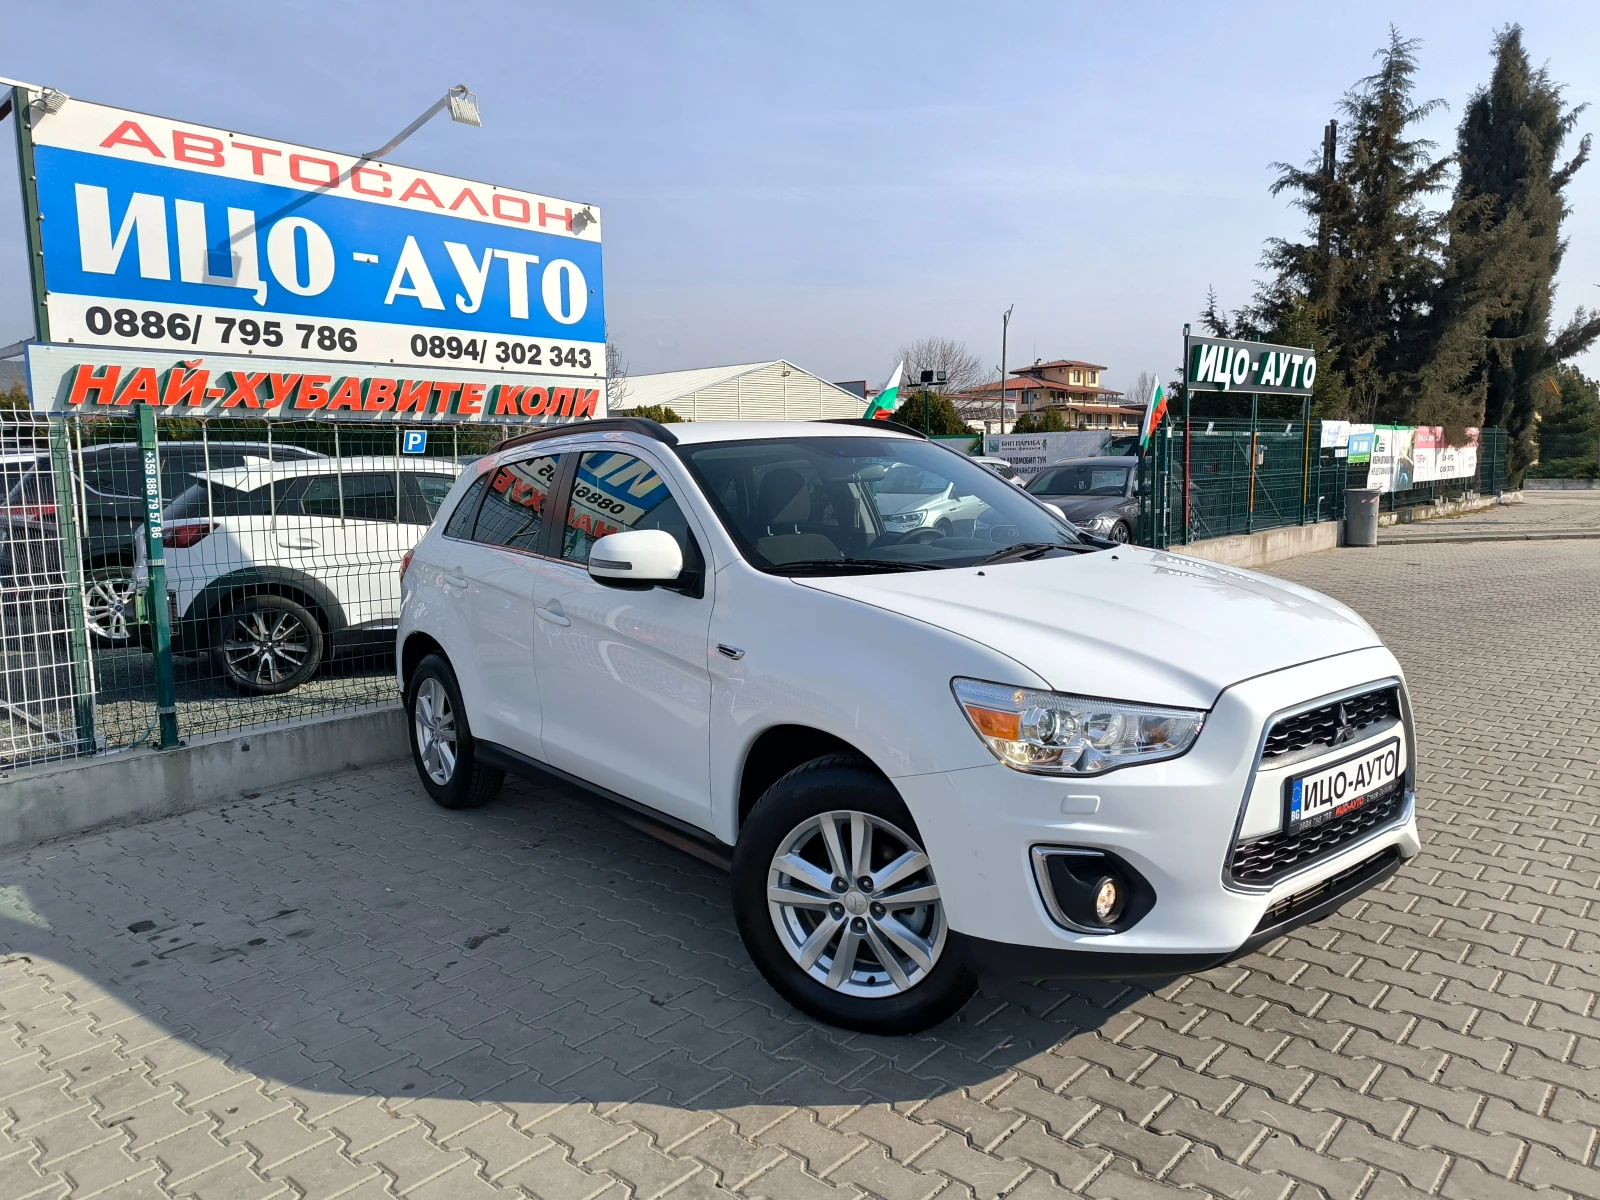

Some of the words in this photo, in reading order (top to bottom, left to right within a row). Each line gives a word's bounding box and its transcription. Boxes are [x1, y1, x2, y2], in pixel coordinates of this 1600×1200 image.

[99, 120, 572, 233] АВТОСАЛОН
[86, 306, 202, 345] 0886/
[215, 316, 283, 348] 795
[296, 323, 358, 353] 786
[410, 334, 487, 364] 0894/
[495, 342, 542, 366] 302
[549, 347, 592, 369] 343
[69, 359, 487, 415] НАЙ-ХУБАВИТЕ
[500, 386, 600, 418] КОЛИ
[407, 433, 422, 450] P
[145, 451, 156, 475] +359
[146, 478, 158, 496] 886
[147, 498, 159, 510] 79
[149, 512, 160, 524] 57
[151, 527, 162, 539] 86
[1304, 750, 1395, 812] ИЦО-АУТО
[1291, 809, 1300, 821] BG
